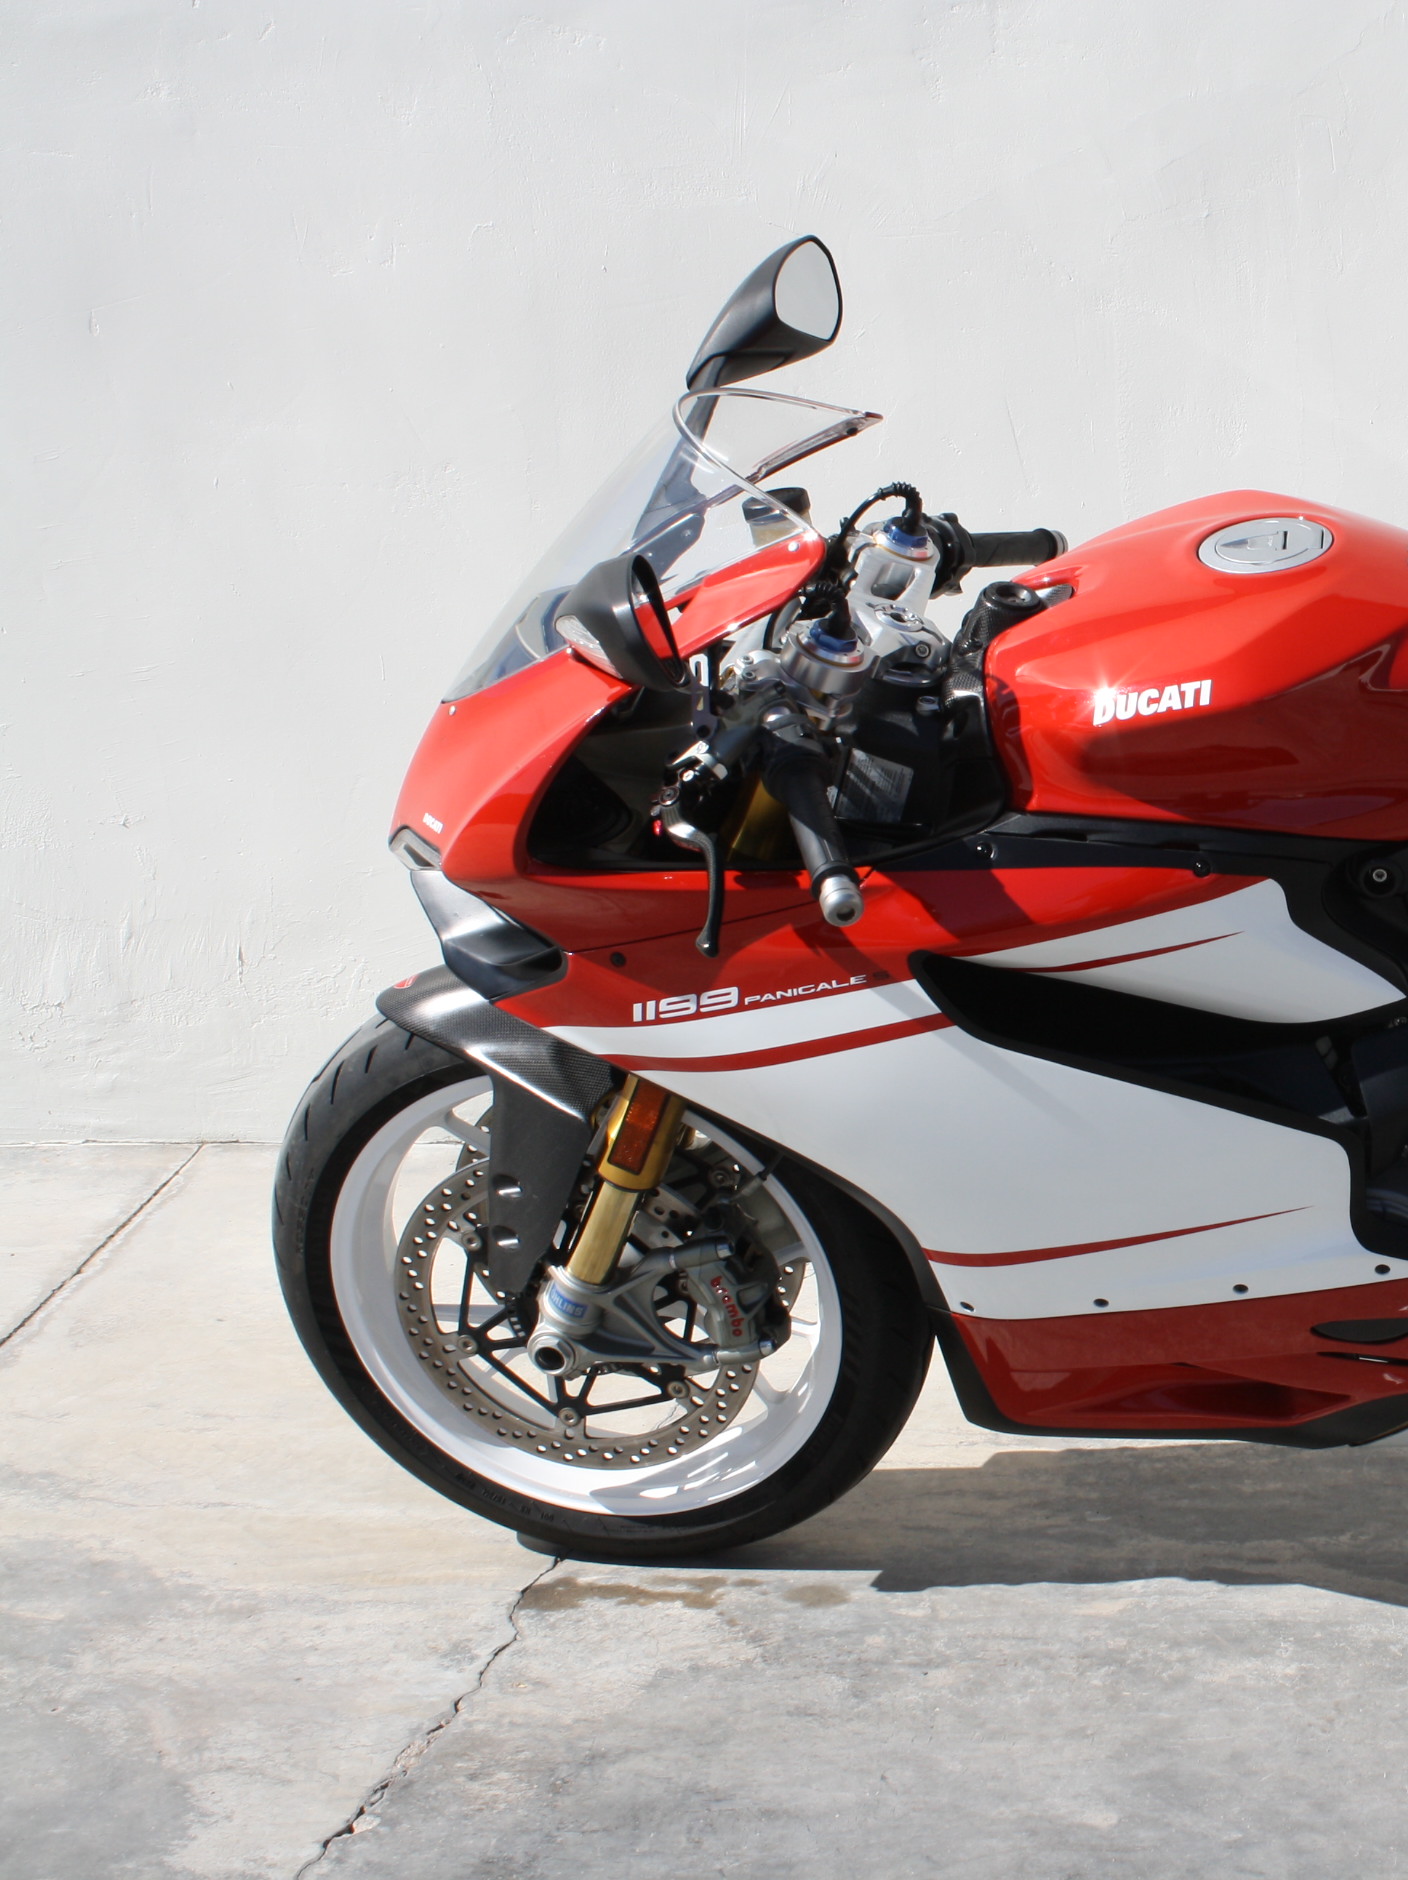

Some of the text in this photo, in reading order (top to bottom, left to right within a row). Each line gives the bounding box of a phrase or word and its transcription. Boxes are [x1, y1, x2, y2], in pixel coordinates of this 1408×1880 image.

[1093, 679, 1212, 727] DUCATI
[632, 986, 740, 1023] 1199
[710, 1275, 745, 1337] brembo
